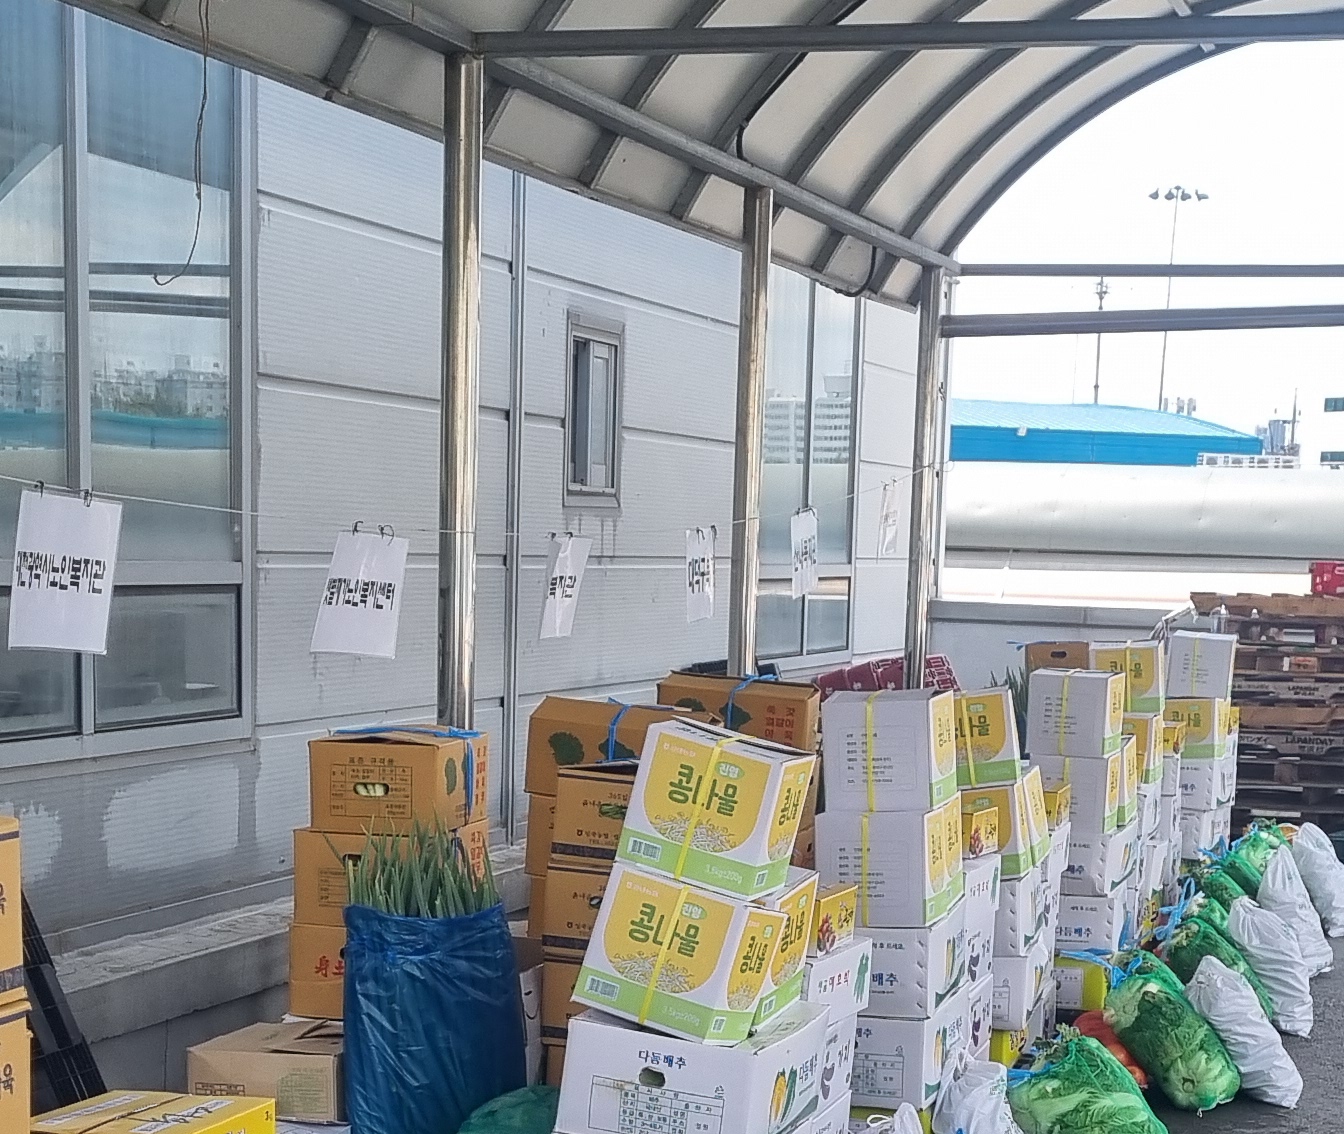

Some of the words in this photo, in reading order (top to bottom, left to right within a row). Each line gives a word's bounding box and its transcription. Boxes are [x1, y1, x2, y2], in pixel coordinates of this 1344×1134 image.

[1285, 736, 1335, 747] LAPANDAY
[668, 763, 738, 817] 콩나물
[628, 902, 700, 957] 콩나물
[638, 1049, 688, 1070] 다듬배추
